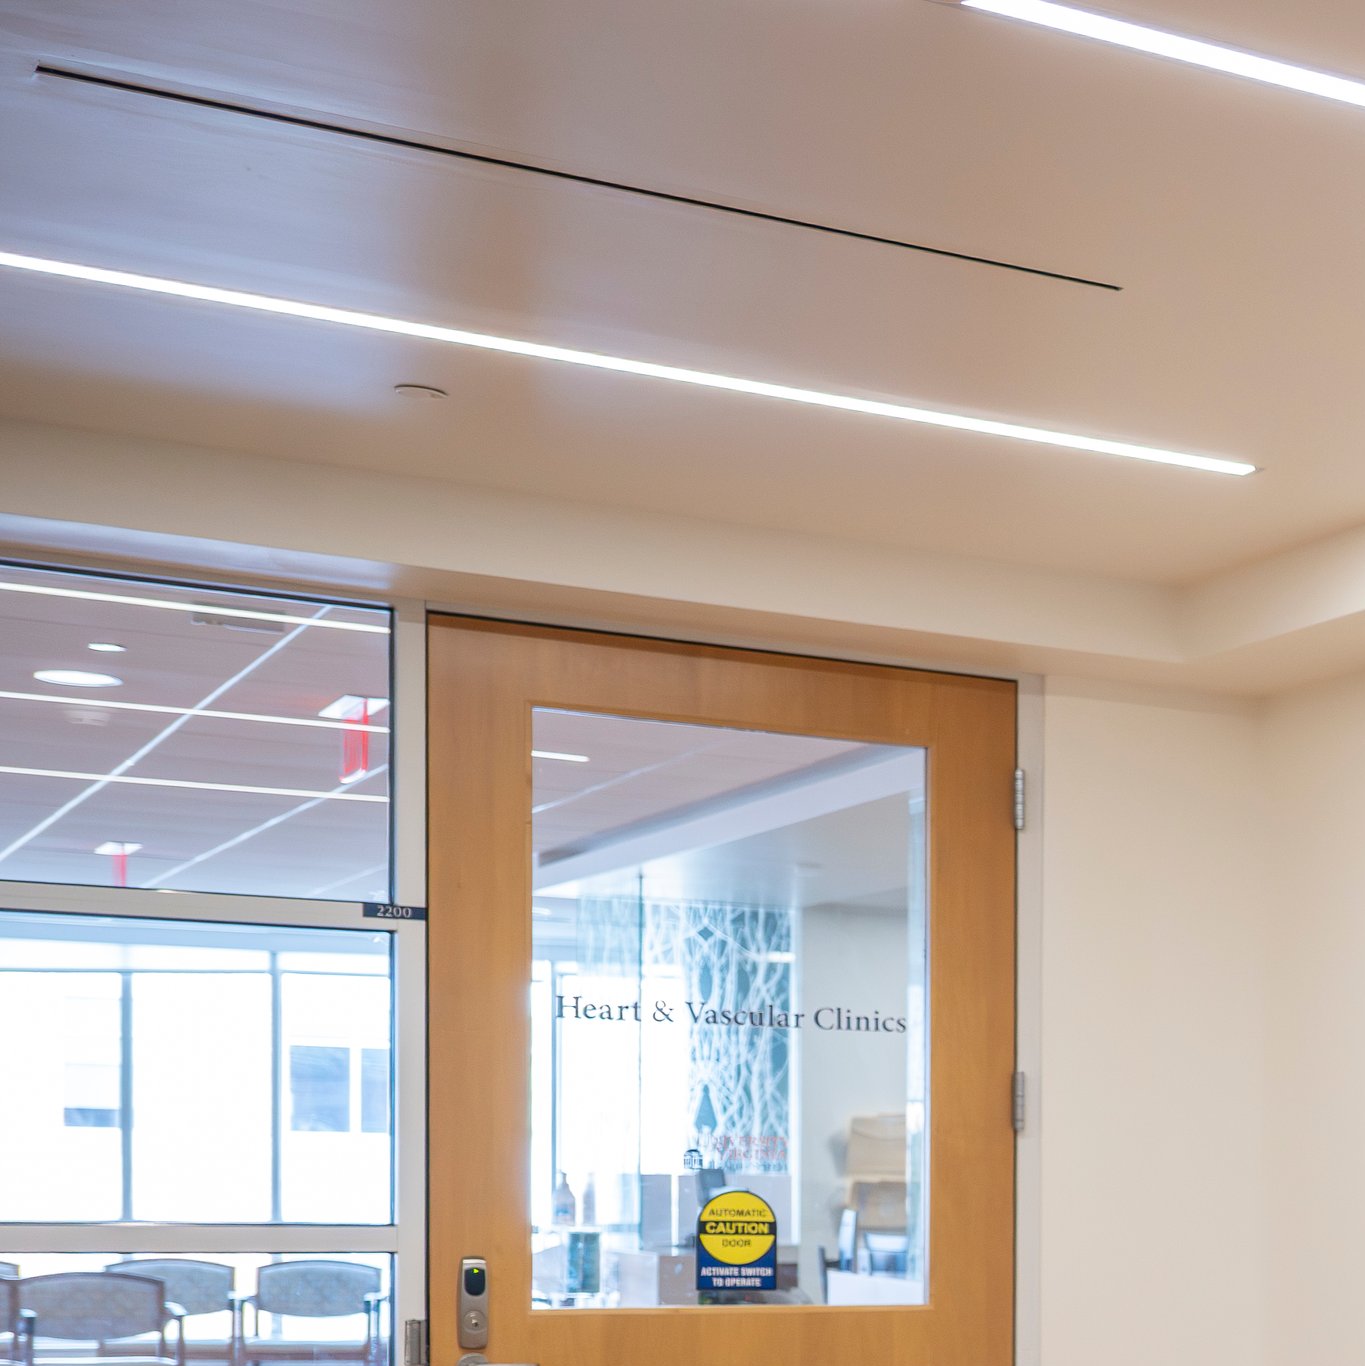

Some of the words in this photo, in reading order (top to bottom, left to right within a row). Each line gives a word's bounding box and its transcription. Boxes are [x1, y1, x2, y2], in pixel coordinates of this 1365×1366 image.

[376, 904, 412, 918] 2200
[556, 995, 642, 1022] Heart
[653, 1000, 674, 1022] &
[685, 1001, 804, 1028] Vascular
[814, 1007, 907, 1033] Clinics
[708, 1208, 767, 1217] AUTOMATIC
[705, 1222, 770, 1234] CAUTION
[722, 1239, 751, 1247] DOOR
[701, 1267, 739, 1276] ACTIVATE
[740, 1267, 773, 1276] SWITCH
[712, 1277, 723, 1287] TO
[725, 1277, 762, 1287] OPERATE
